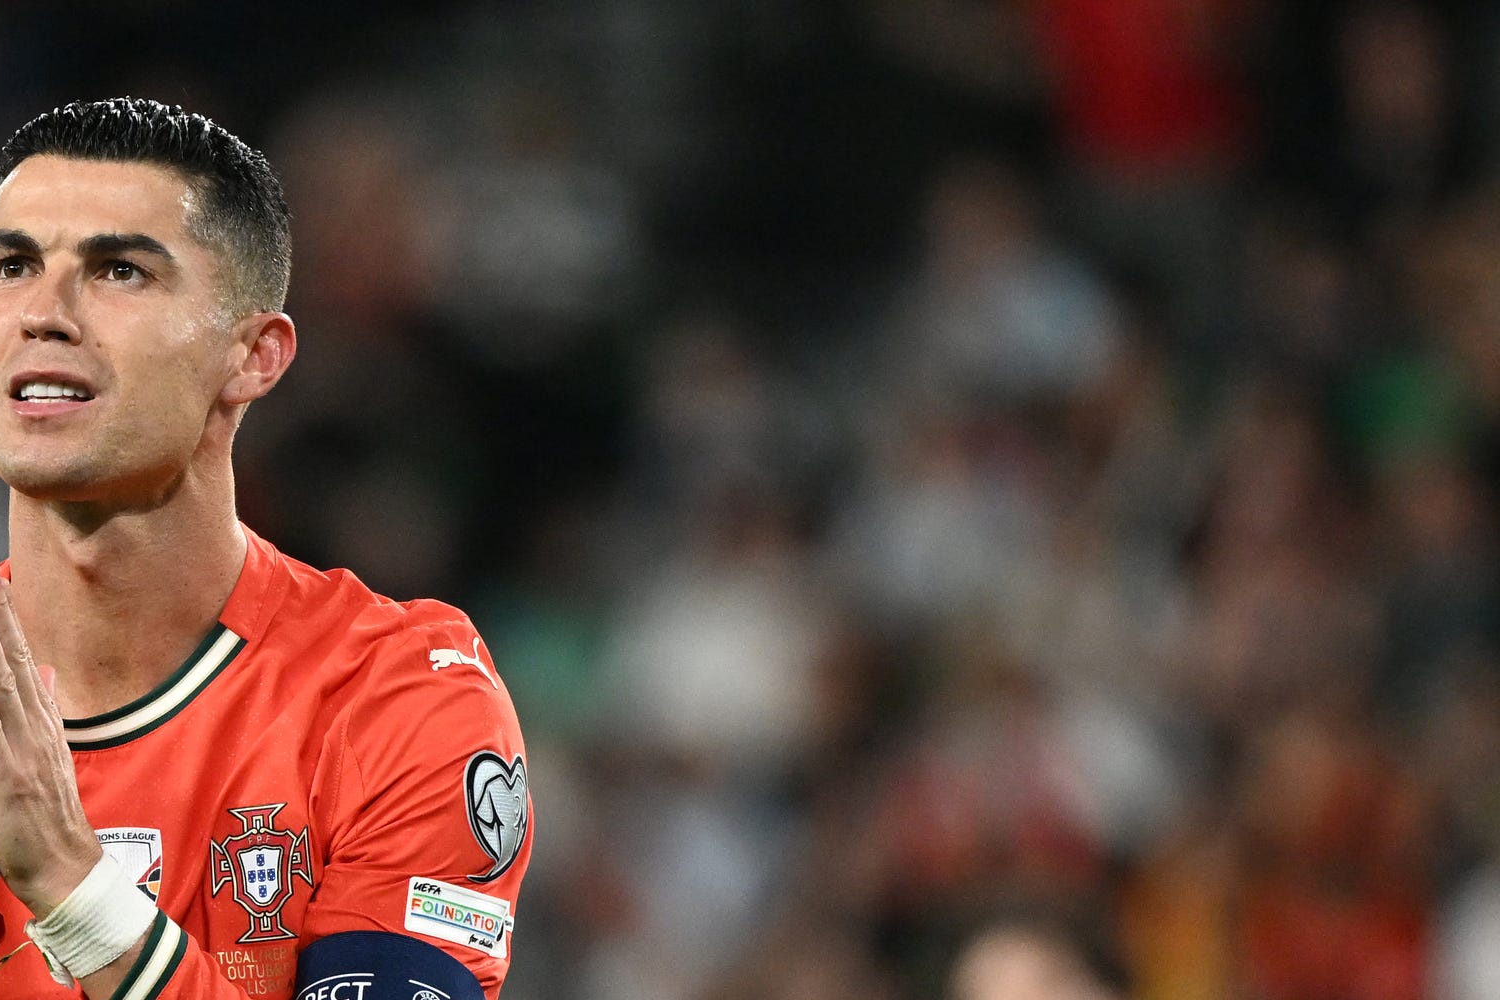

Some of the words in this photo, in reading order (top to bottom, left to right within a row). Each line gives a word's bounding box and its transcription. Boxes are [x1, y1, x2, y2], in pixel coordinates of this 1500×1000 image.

[122, 832, 157, 841] LEAGUE
[413, 882, 442, 895] UEFA
[216, 950, 258, 965] TUGAL
